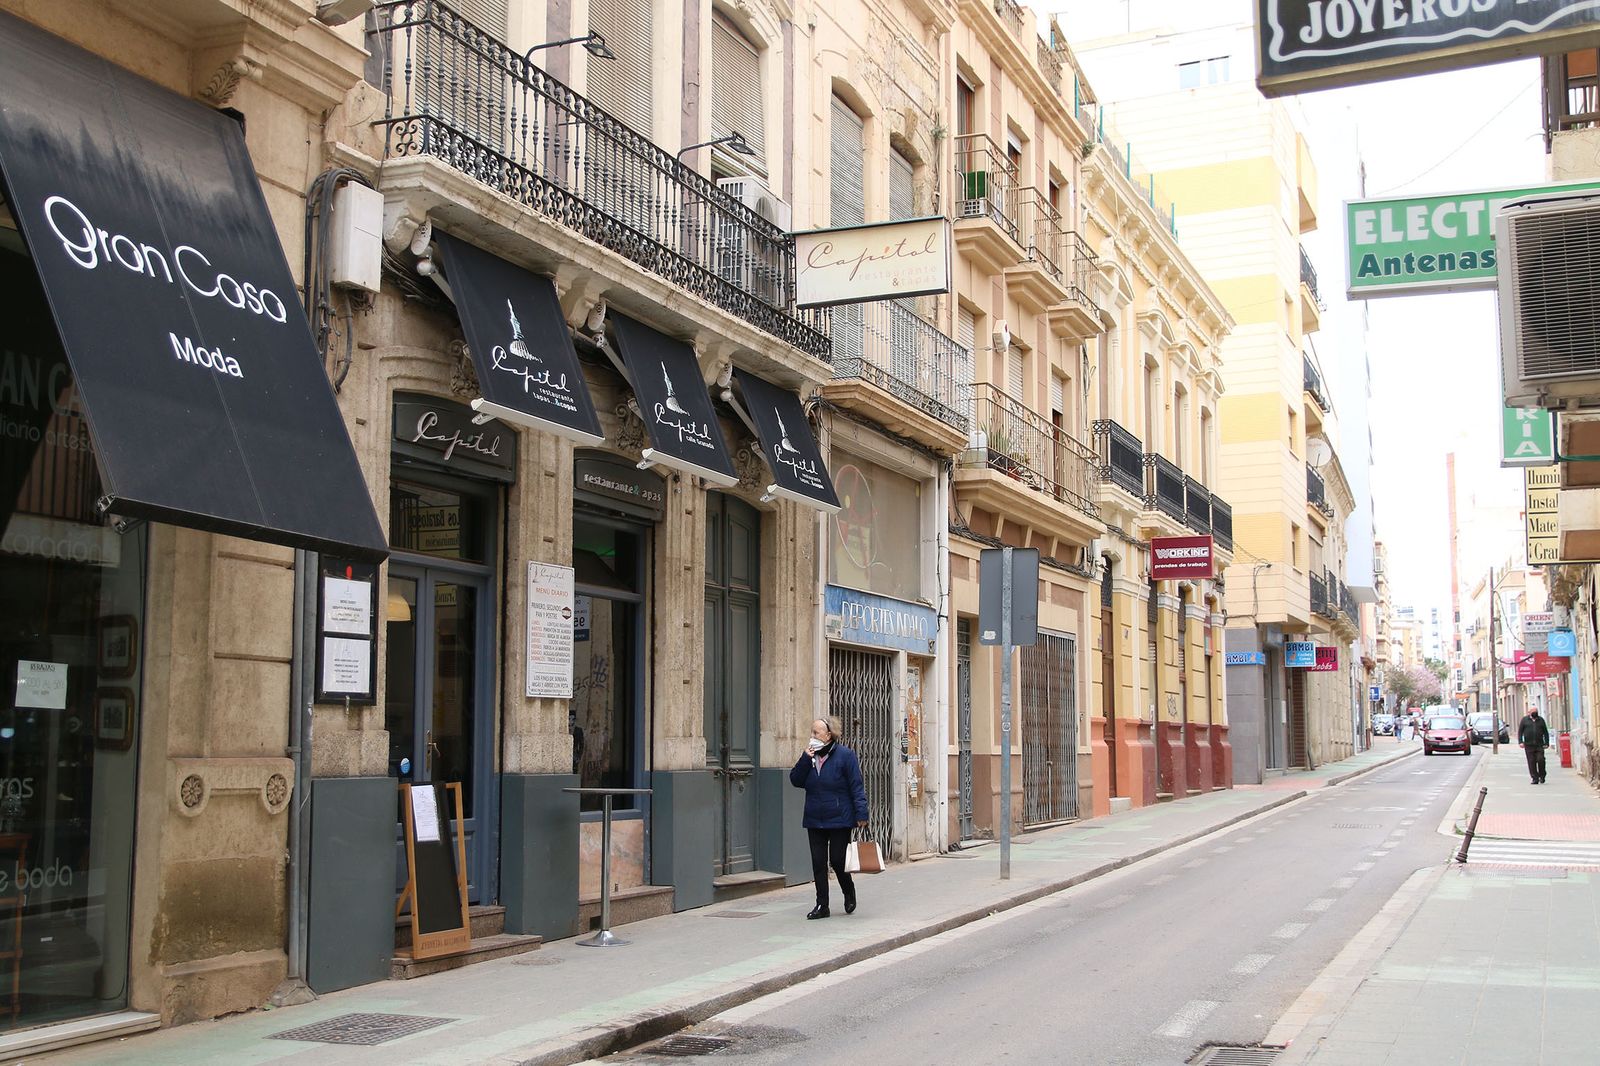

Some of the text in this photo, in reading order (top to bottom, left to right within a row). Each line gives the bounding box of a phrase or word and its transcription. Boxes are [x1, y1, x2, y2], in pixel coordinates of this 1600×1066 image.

[800, 232, 937, 282] Capitol
[858, 265, 937, 280] restaurante
[1356, 249, 1496, 279] Antenas
[175, 246, 287, 323] Casa
[169, 332, 244, 379] Moda
[492, 345, 571, 393] Capitol
[412, 411, 501, 461] Capitol
[654, 402, 712, 443] Capitol
[773, 443, 819, 478] Capitol
[1529, 518, 1558, 534] Mate
[1154, 546, 1209, 559] WORKING
[1187, 561, 1208, 569] trabajo
[842, 600, 896, 636] DEPORTES
[896, 611, 929, 641] INDALO
[1286, 642, 1314, 651] BAMBI
[14, 856, 73, 890] boda
